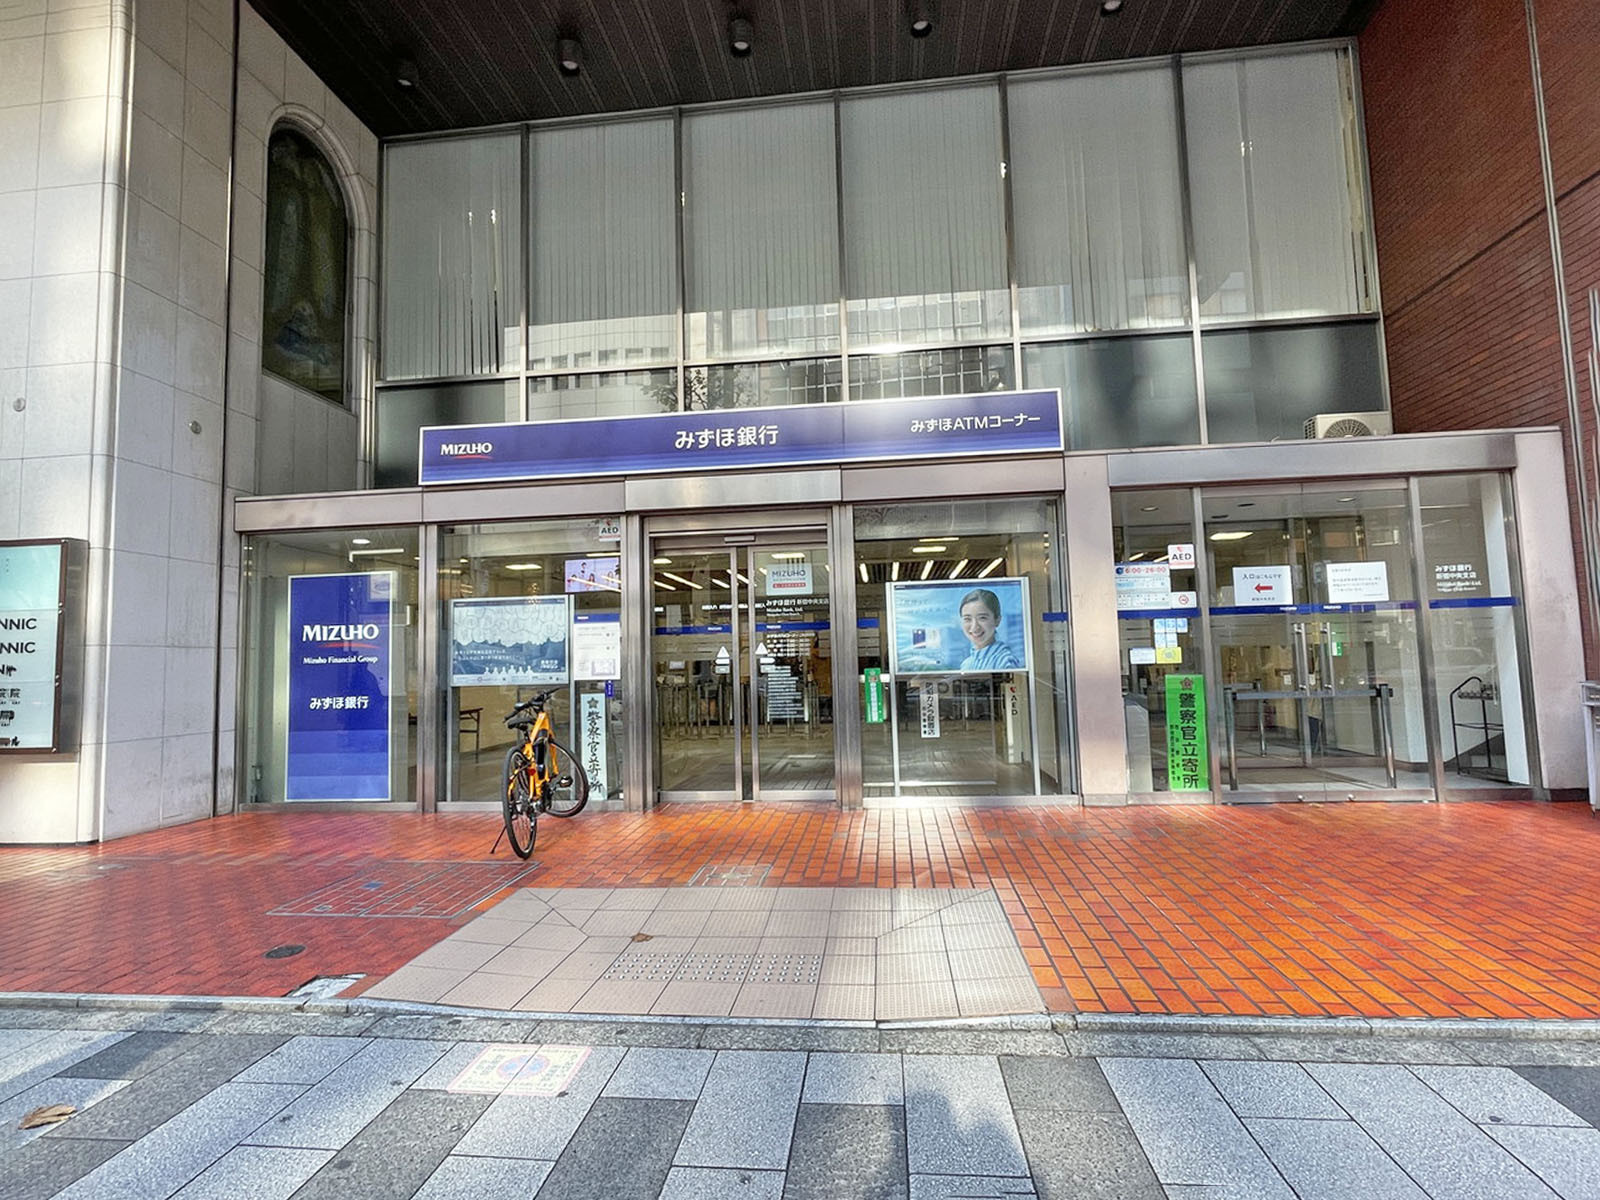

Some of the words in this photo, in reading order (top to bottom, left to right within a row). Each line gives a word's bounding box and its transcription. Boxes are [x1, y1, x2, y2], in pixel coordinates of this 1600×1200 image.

[910, 412, 1041, 433] みずほATMコーナー
[674, 425, 779, 449] みずほ銀行
[440, 442, 493, 456] MIZUHO
[601, 526, 619, 534] AED
[1171, 552, 1192, 560] AED
[772, 569, 806, 578] MIZUHO
[302, 623, 380, 642] MIZUHO
[328, 655, 356, 664] Financial
[357, 655, 378, 664] Group
[309, 695, 370, 710] みずほ銀行
[1179, 692, 1200, 789] 警察官立寄所
